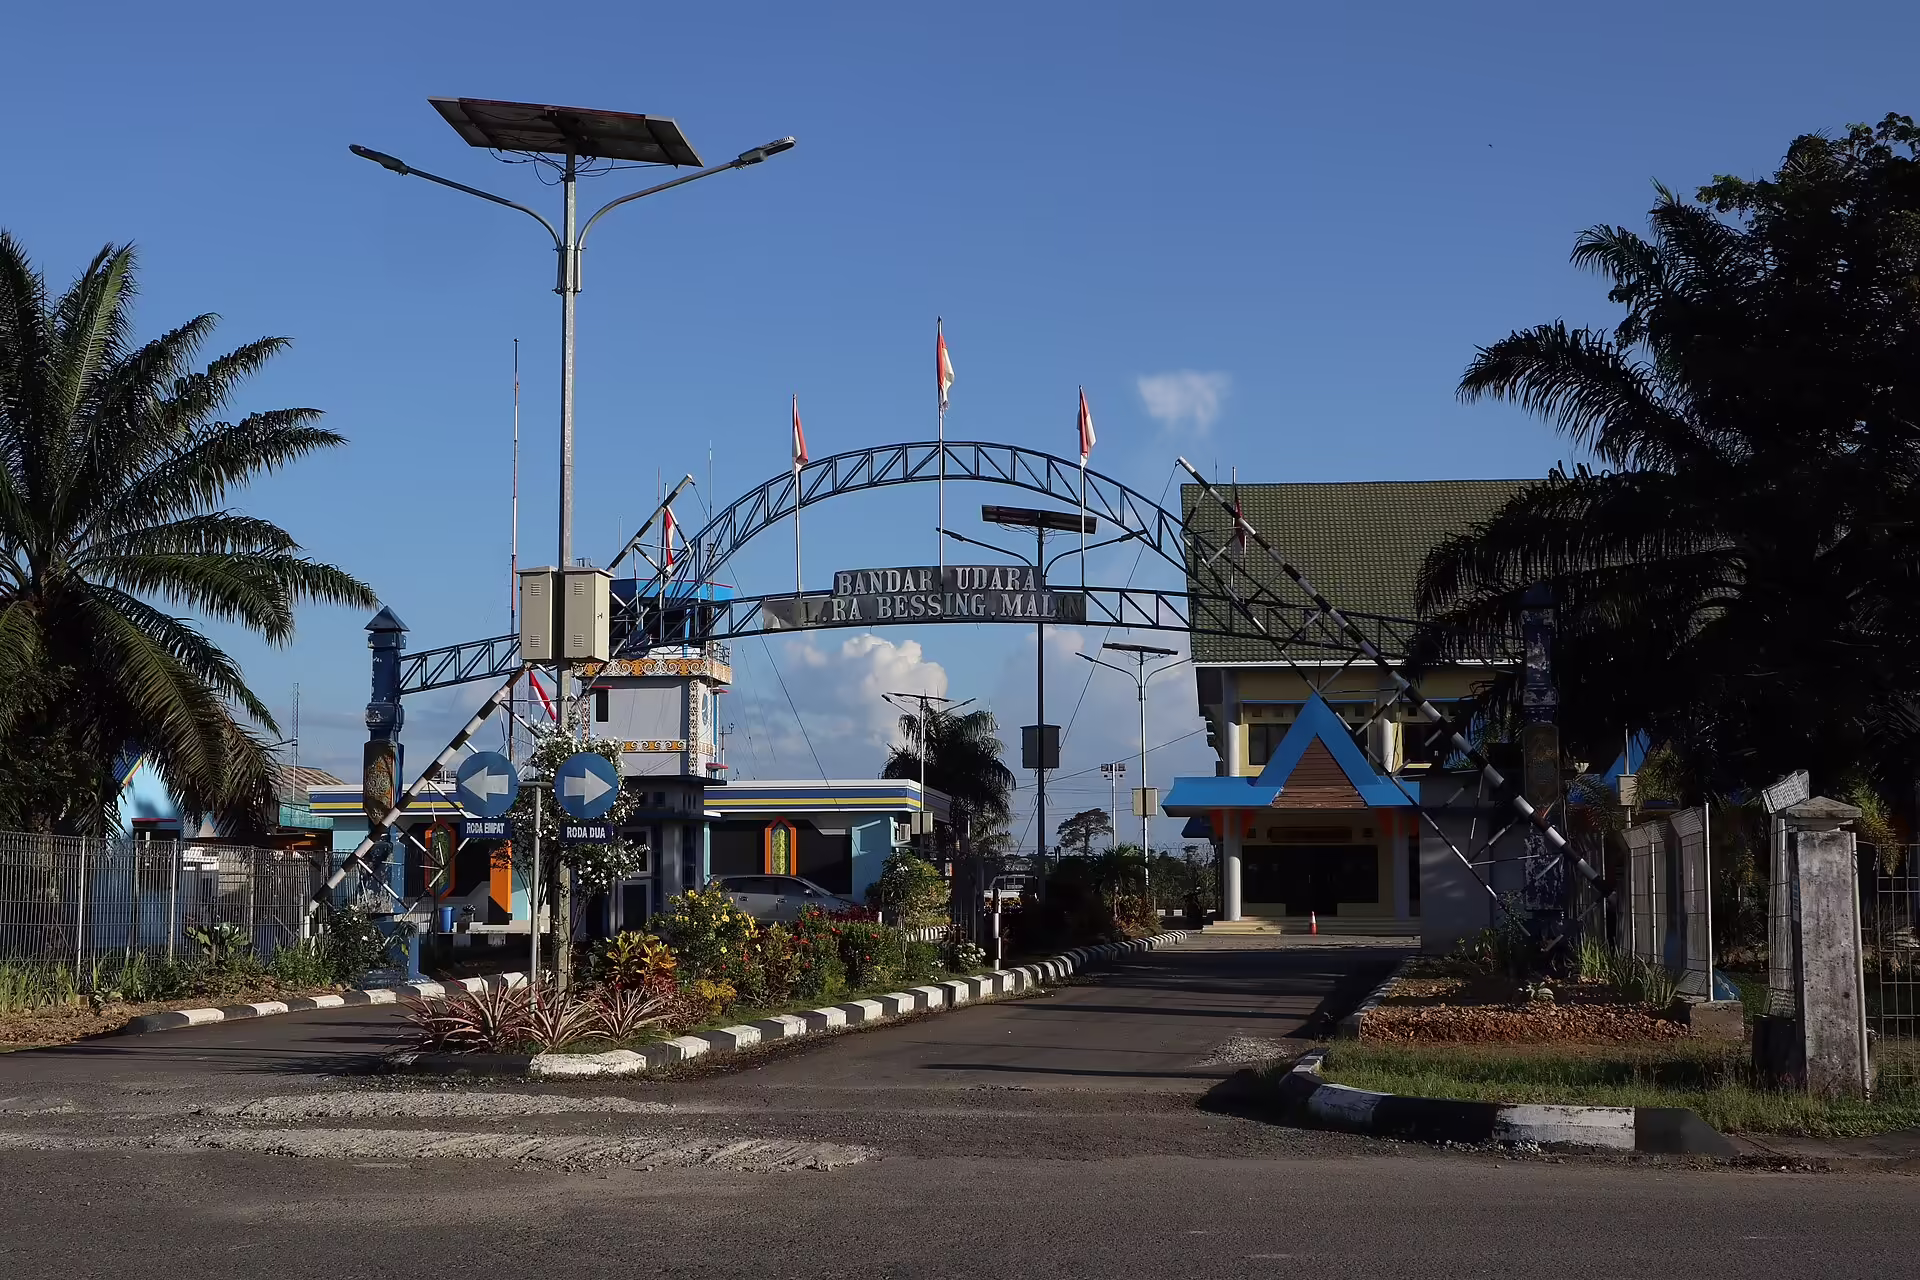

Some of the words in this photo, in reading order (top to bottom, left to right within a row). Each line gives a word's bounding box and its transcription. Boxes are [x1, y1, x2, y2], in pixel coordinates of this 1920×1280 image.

[836, 569, 935, 596] BANDAR
[955, 566, 1037, 592] UDARA
[466, 822, 483, 834] RODA
[484, 822, 505, 834] EMPAT
[566, 826, 588, 839] RODA
[589, 826, 606, 839] DUA
